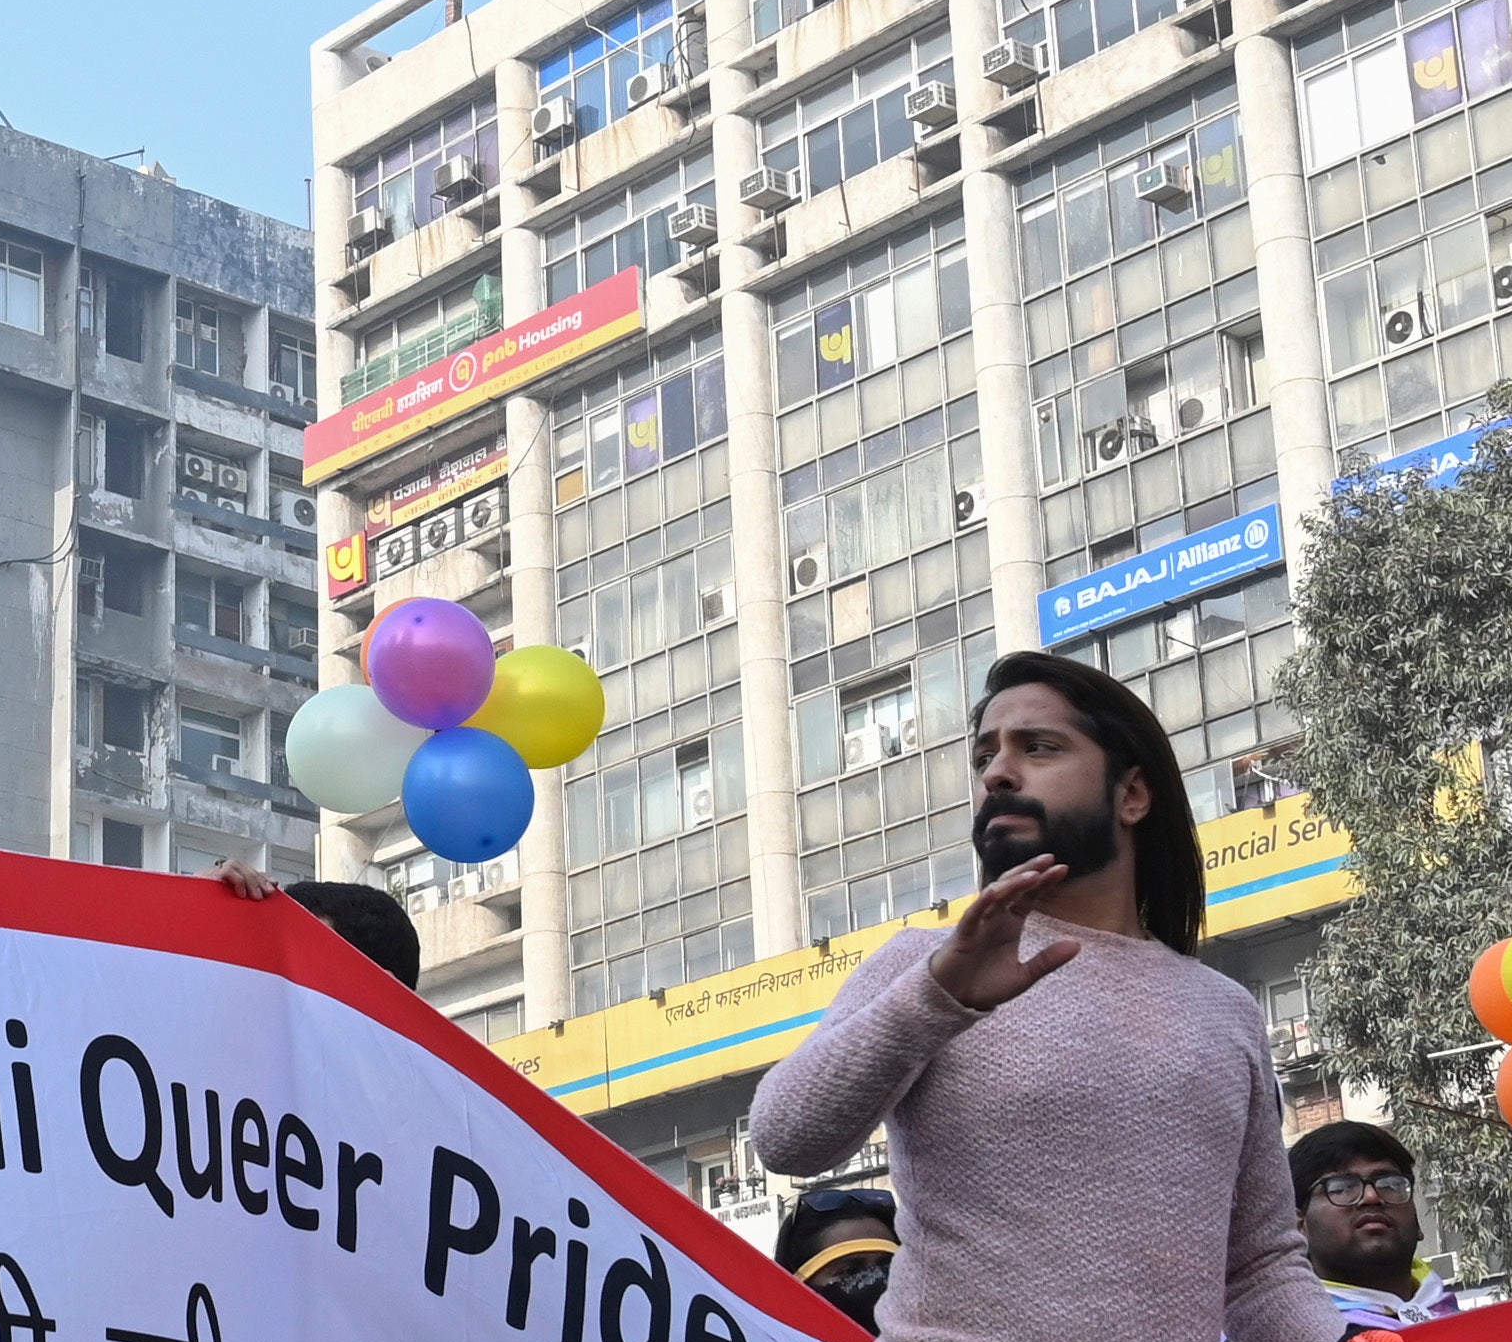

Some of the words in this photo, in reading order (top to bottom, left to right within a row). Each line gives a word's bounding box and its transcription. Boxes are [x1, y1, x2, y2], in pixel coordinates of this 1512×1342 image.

[482, 339, 517, 373] pnb
[518, 310, 583, 352] Housing
[351, 397, 394, 433] पीएनबी
[393, 475, 432, 501] पंजाब
[1076, 559, 1167, 609] BAJAJ
[1176, 532, 1242, 573] Allianz
[1206, 824, 1278, 871] ancial
[1287, 818, 1348, 847] Serv
[665, 991, 711, 1027] एल&टी
[79, 1033, 384, 1254] Queer
